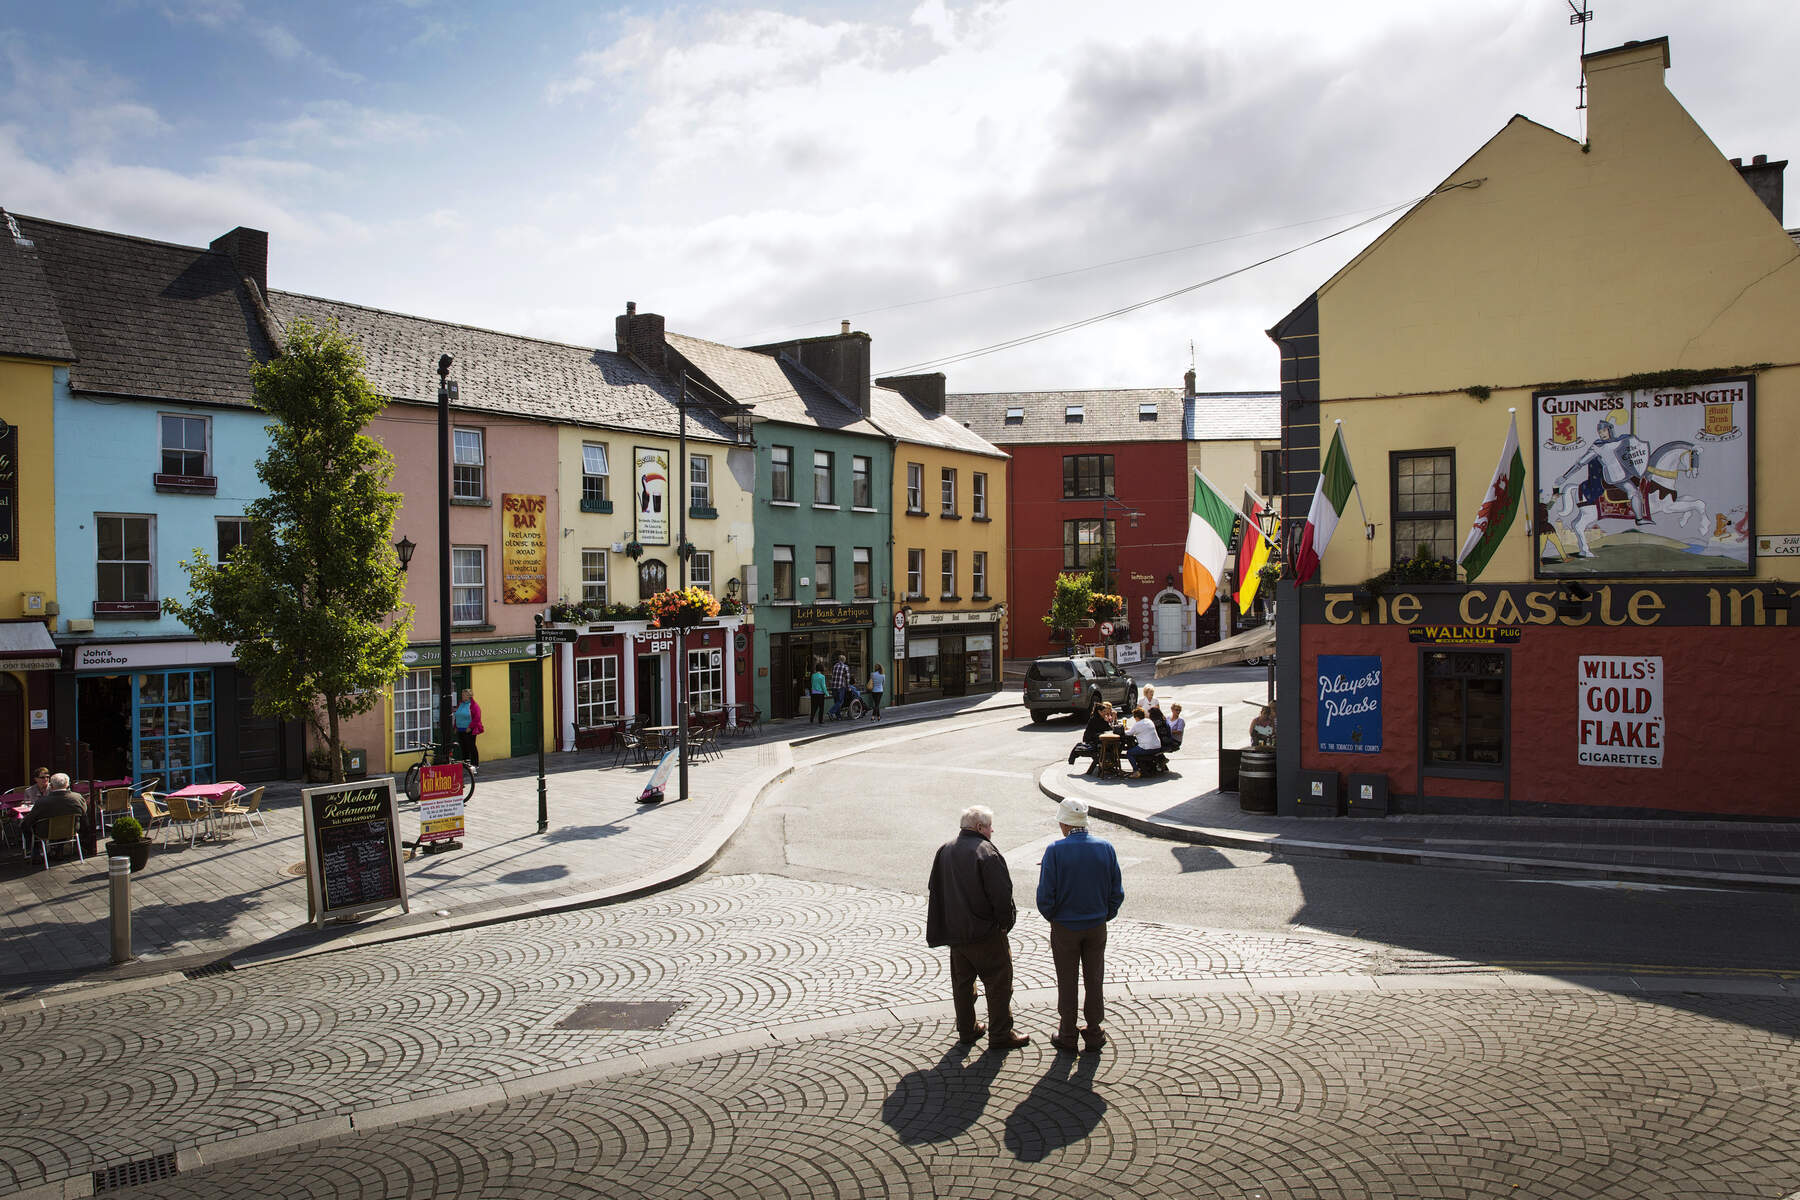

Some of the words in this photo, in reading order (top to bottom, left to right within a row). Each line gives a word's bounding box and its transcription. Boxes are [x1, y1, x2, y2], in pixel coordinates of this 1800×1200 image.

[1541, 397, 1624, 415] GUINNESS
[1633, 400, 1649, 409] FOR
[1653, 388, 1744, 408] STRENGTH
[1709, 416, 1729, 424] Drink
[1621, 450, 1646, 461] Castle
[513, 514, 537, 528] BAR
[797, 608, 813, 618] Left
[816, 608, 834, 617] Bank
[838, 607, 868, 618] Antiques
[911, 615, 919, 624] 17
[989, 613, 996, 621] 17
[1425, 626, 1498, 639] WALNUT
[1500, 629, 1520, 637] PLUG
[83, 649, 112, 657] John's
[651, 640, 673, 653] Bar
[83, 657, 128, 665] bookshop
[1319, 670, 1381, 701] Player's
[1325, 696, 1377, 727] Please
[1336, 743, 1353, 751] TOBACCO
[1364, 744, 1380, 752] COUNTS
[422, 773, 434, 792] kin
[335, 789, 378, 805] Melody
[322, 803, 381, 819] Restaurant
